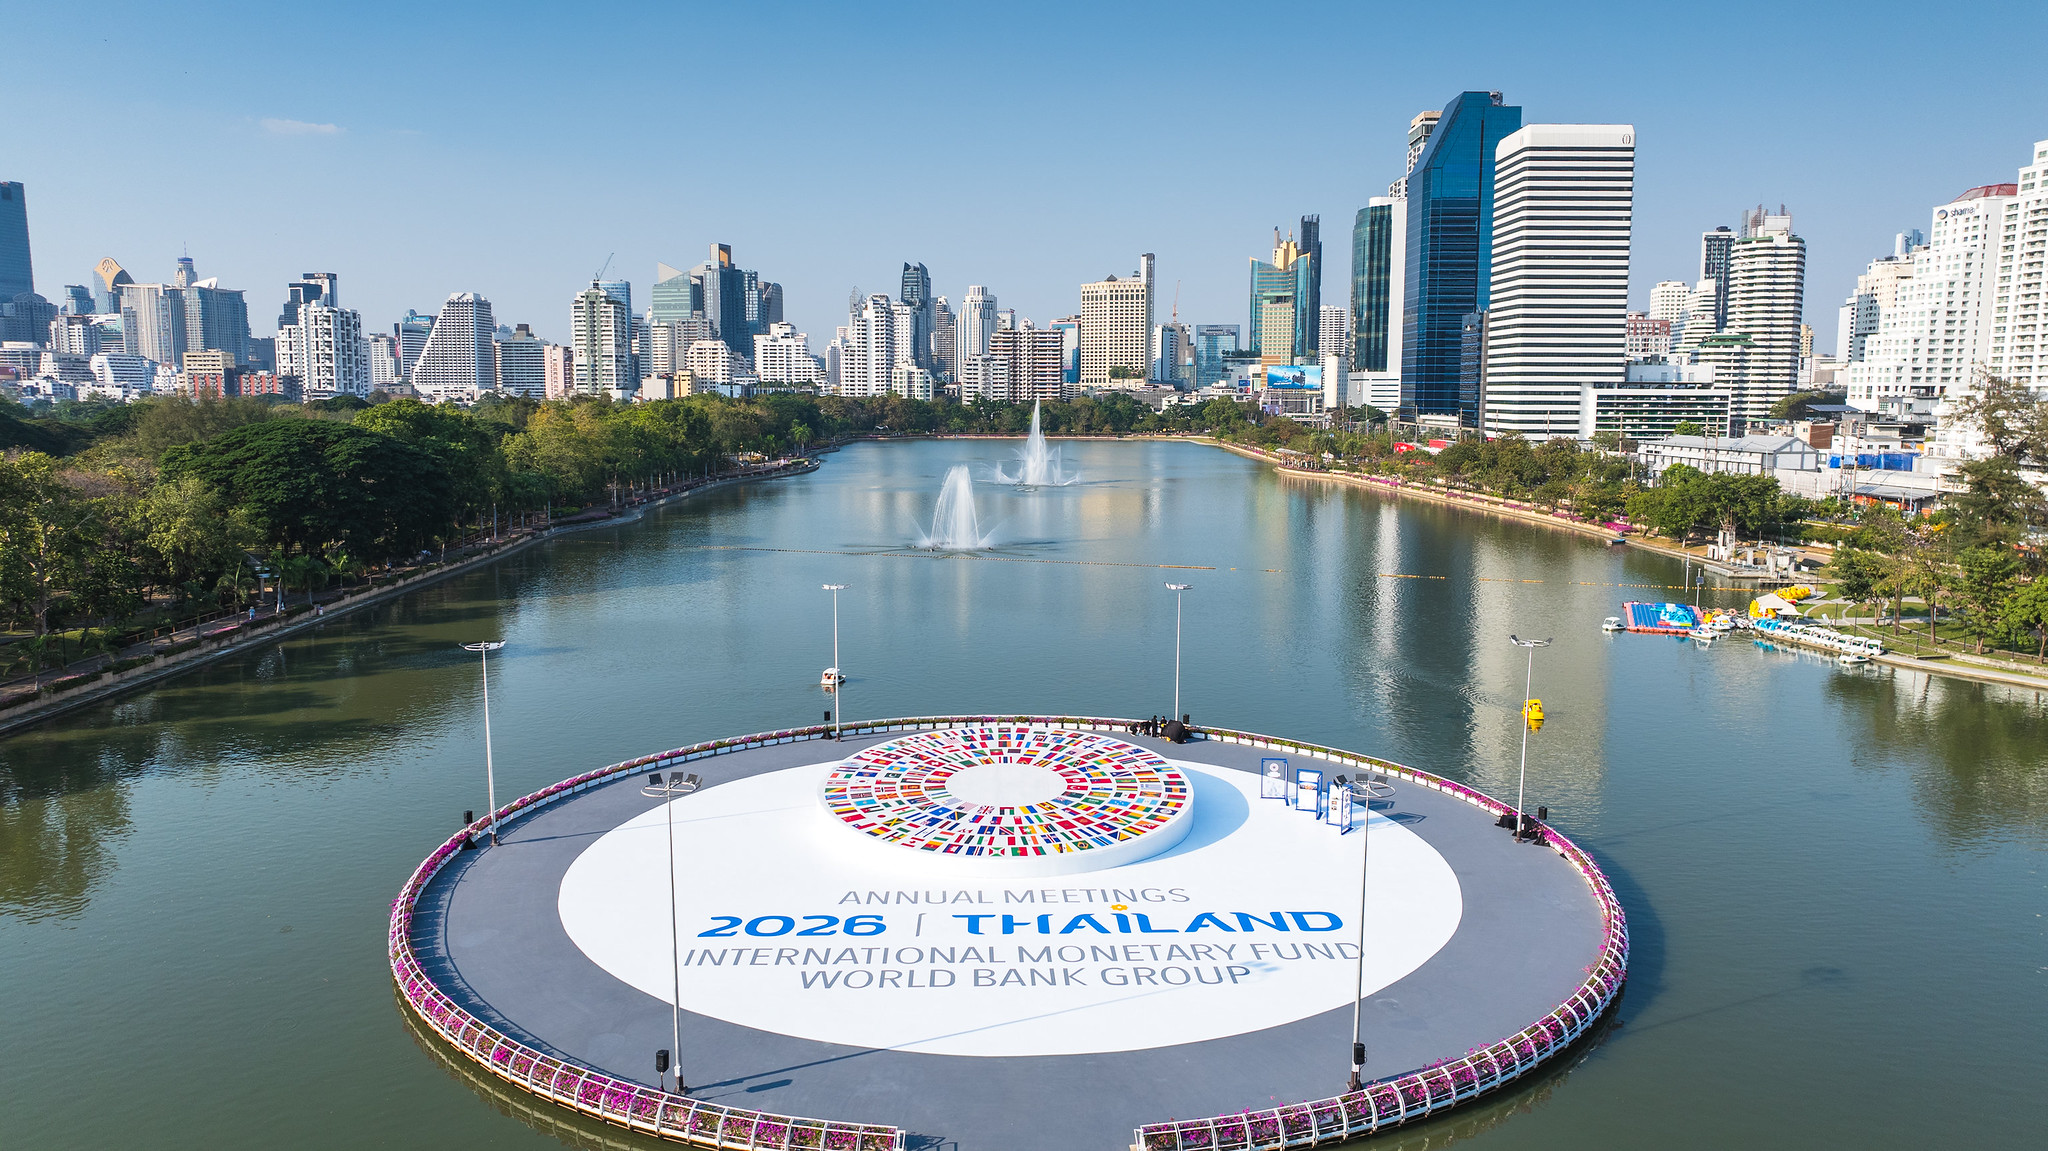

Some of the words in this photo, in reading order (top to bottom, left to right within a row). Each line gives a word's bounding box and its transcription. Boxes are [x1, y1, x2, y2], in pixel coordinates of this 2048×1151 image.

[837, 890, 995, 905] ANNUAL
[1003, 888, 1191, 904] MEETINGS
[696, 914, 888, 938] 2026
[683, 946, 1006, 967] INTERNATIONAL
[1017, 943, 1238, 963] MONETARY
[1249, 942, 1365, 961] FUND
[800, 969, 957, 990] WORLD
[973, 967, 1088, 987] BANK
[1100, 966, 1252, 986] GROUP
